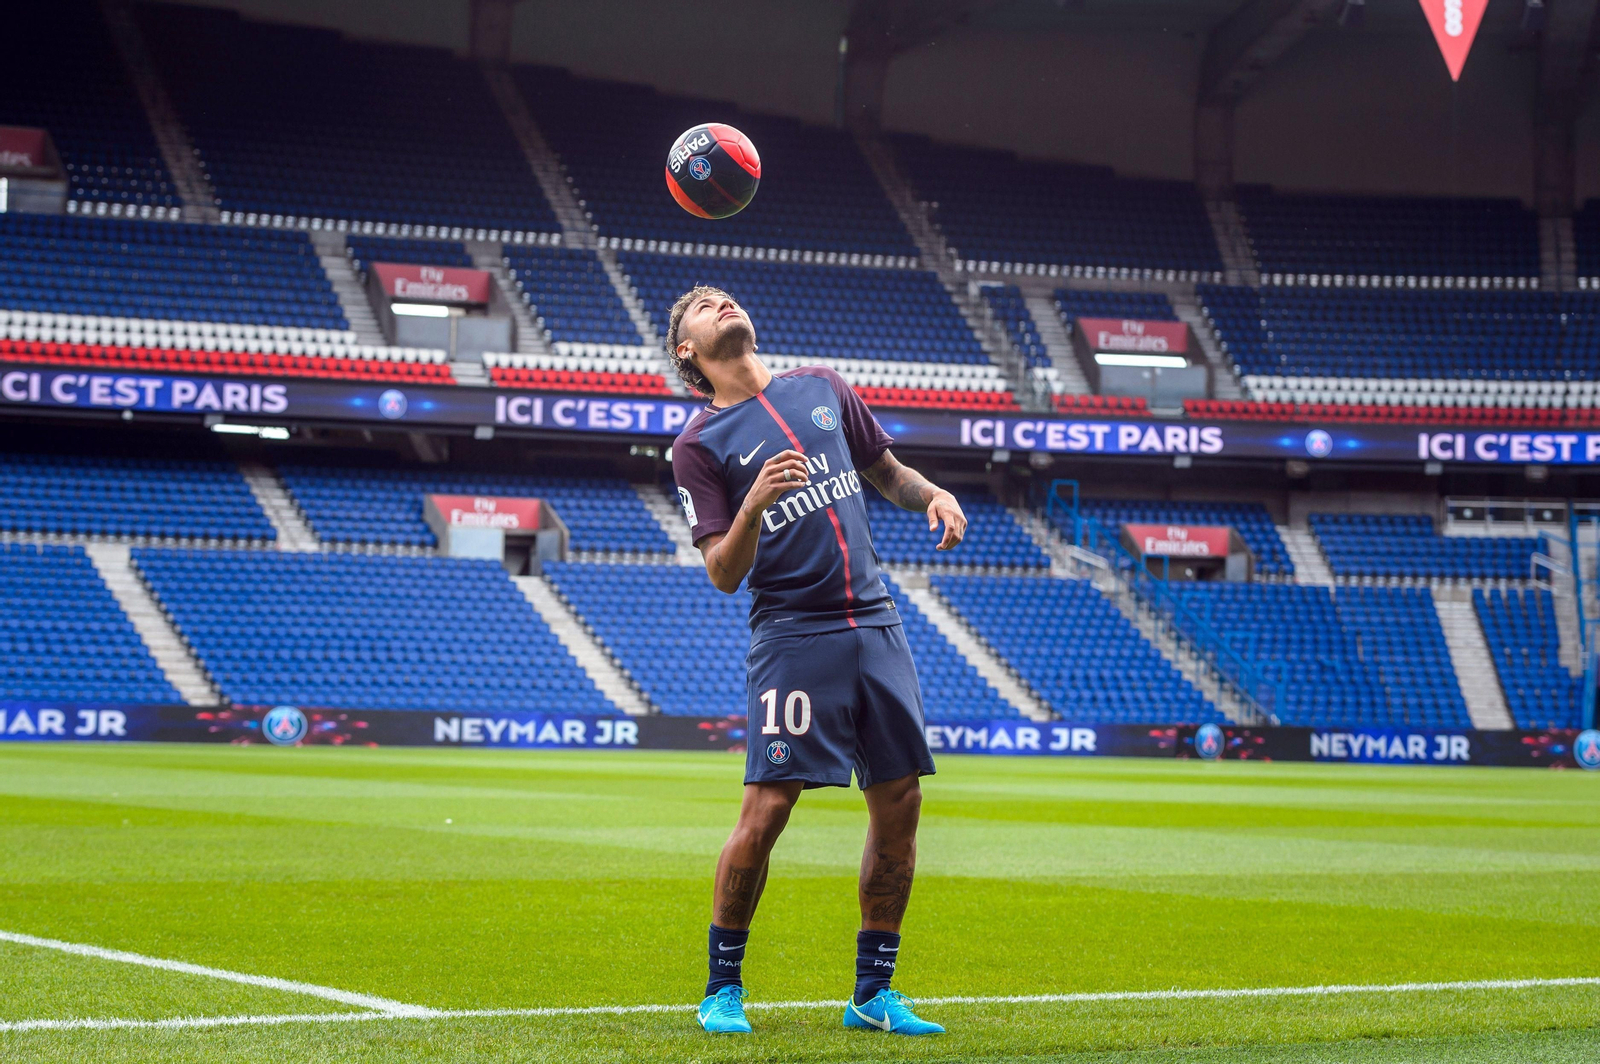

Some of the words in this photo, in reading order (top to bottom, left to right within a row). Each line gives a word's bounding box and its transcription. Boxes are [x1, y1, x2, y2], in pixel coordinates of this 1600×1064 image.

[669, 132, 711, 173] PARIS
[394, 277, 469, 301] Emirates
[1097, 331, 1168, 352] Emirates
[1, 371, 41, 402] CI
[50, 373, 163, 408] C'EST
[171, 379, 289, 414] PARIS
[495, 395, 543, 425] ICI
[552, 399, 655, 431] C'EST
[662, 403, 703, 432] PA
[960, 418, 1005, 447] ICI
[1013, 420, 1111, 450] C'EST
[1118, 424, 1224, 454] PARIS
[1417, 432, 1466, 461] ICI
[1474, 433, 1579, 462] C'EST
[797, 453, 830, 479] ly
[450, 508, 519, 529] Emirates
[1145, 536, 1210, 556] Emirates
[0, 708, 67, 735] AR
[74, 708, 128, 736] JR
[760, 688, 811, 736] 10
[434, 716, 587, 744] NEYMAR
[592, 719, 639, 745] JR
[925, 725, 1042, 750] EYMAR
[1049, 727, 1098, 752] JR
[1310, 732, 1428, 760] NEYMAR
[1432, 735, 1471, 761] JR
